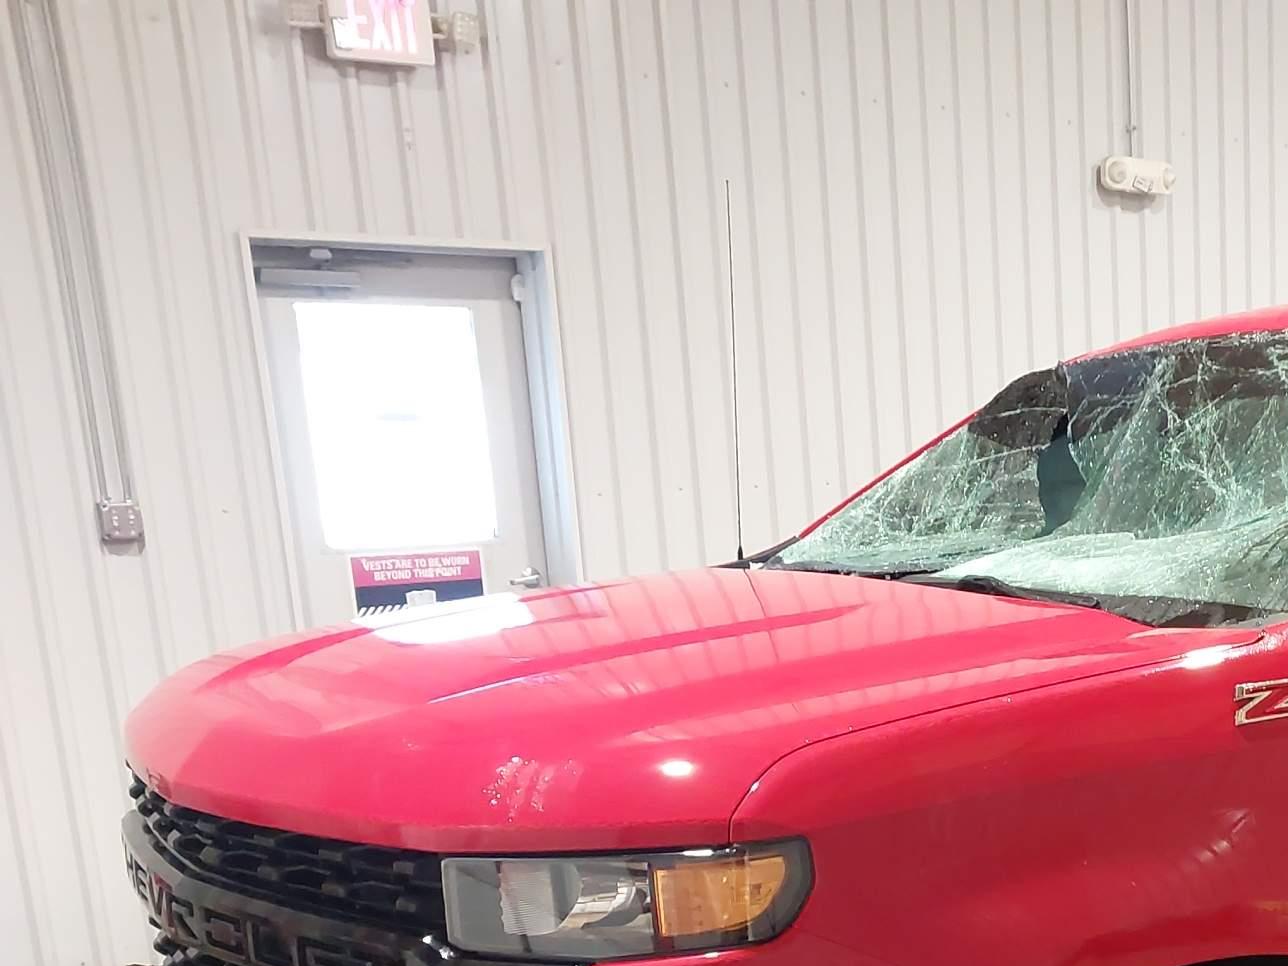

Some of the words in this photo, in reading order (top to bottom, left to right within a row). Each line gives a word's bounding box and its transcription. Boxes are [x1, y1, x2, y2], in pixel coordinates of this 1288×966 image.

[346, 0, 418, 54] EXIT
[361, 558, 392, 571] VESTS
[395, 559, 413, 569] ARE
[414, 558, 426, 568] TO
[374, 568, 411, 581] BEYOND
[413, 567, 434, 578] THIS
[434, 566, 462, 577] POINT
